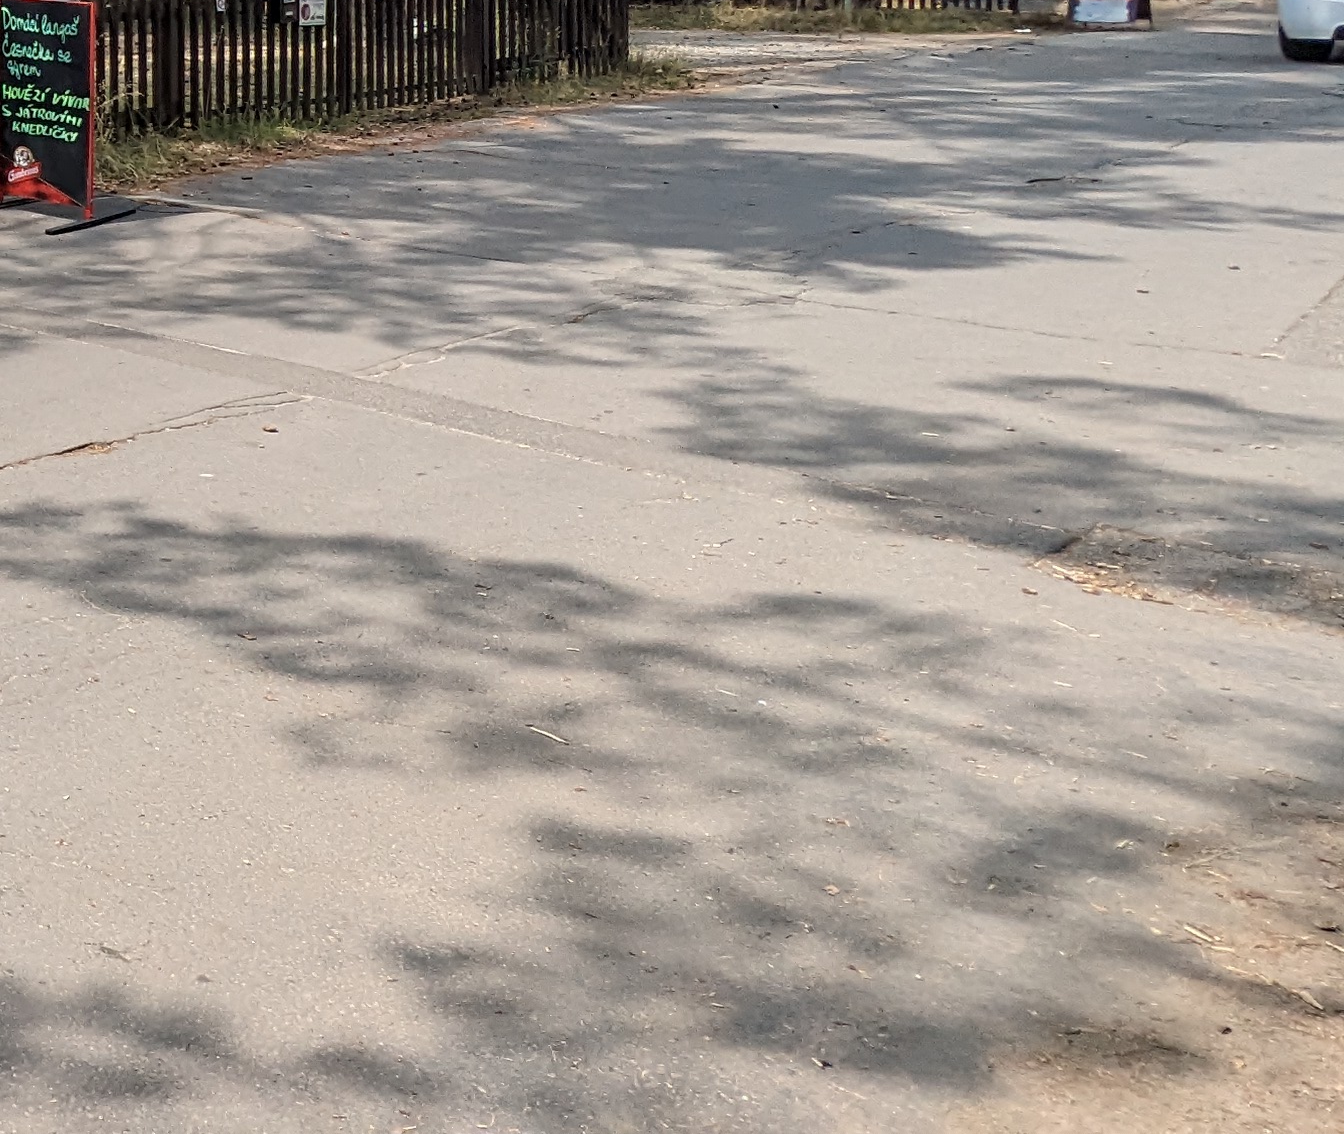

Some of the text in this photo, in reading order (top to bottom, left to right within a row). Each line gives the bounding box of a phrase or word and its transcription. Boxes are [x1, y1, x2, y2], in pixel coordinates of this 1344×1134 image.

[1, 7, 40, 33] Domácí
[2, 31, 72, 63] Česnečka se
[2, 83, 51, 102] HOVĚZÍ
[1, 105, 12, 117] S
